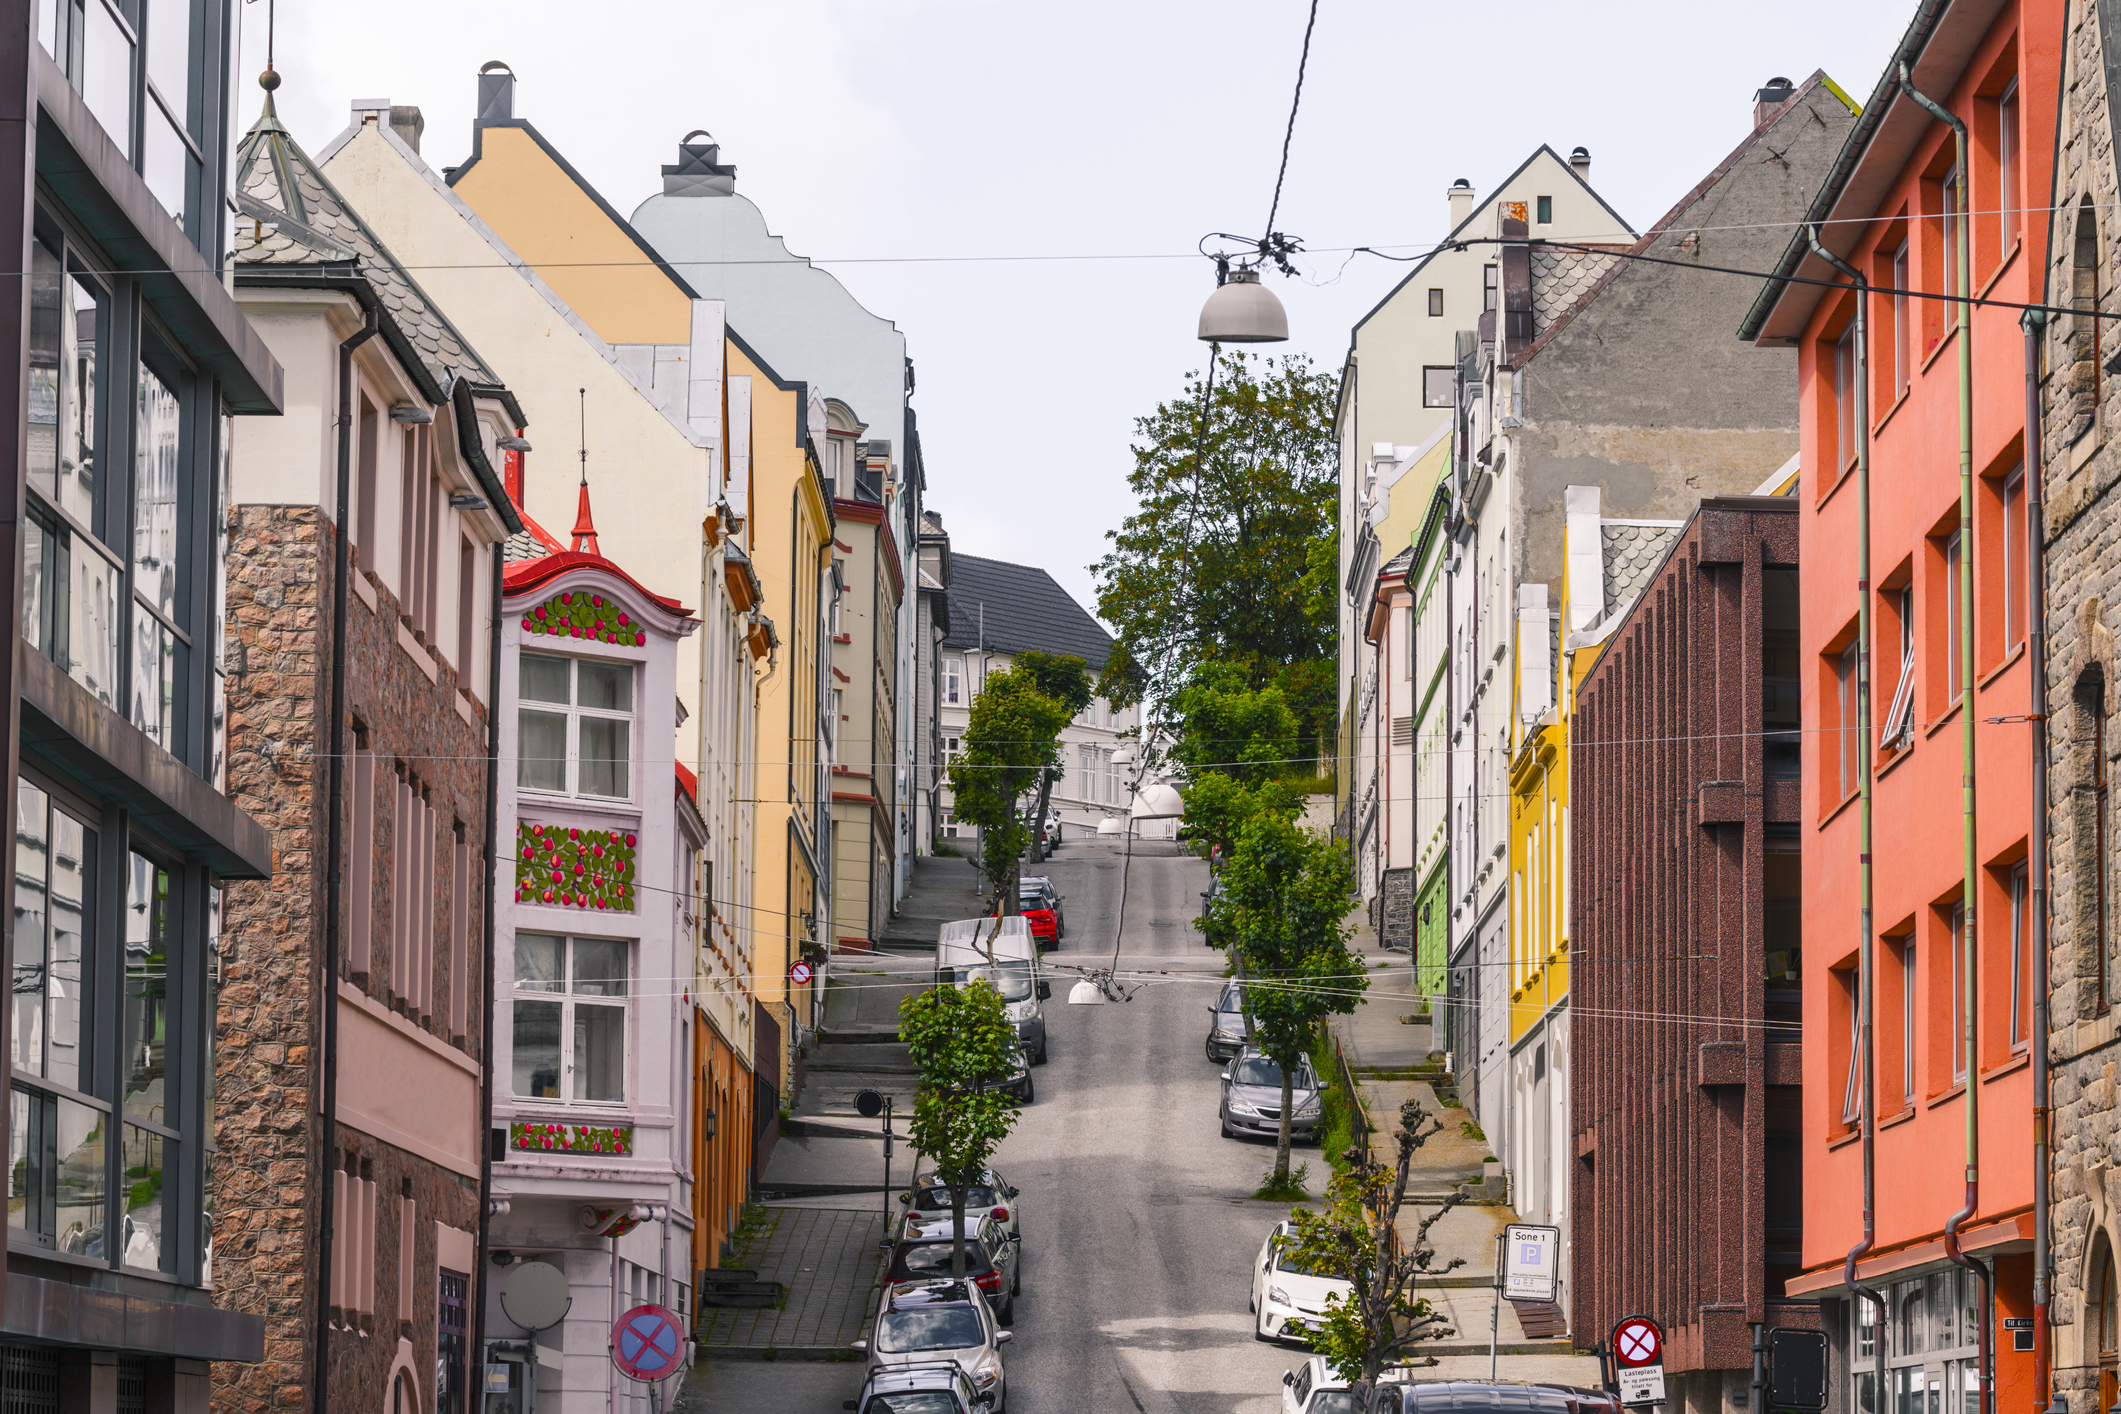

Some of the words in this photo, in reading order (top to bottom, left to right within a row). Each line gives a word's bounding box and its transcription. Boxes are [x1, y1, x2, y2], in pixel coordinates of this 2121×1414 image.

[1515, 1231, 1538, 1241] Sone
[1541, 1234, 1545, 1242] 1
[1624, 1369, 1657, 1377] Lasteplass
